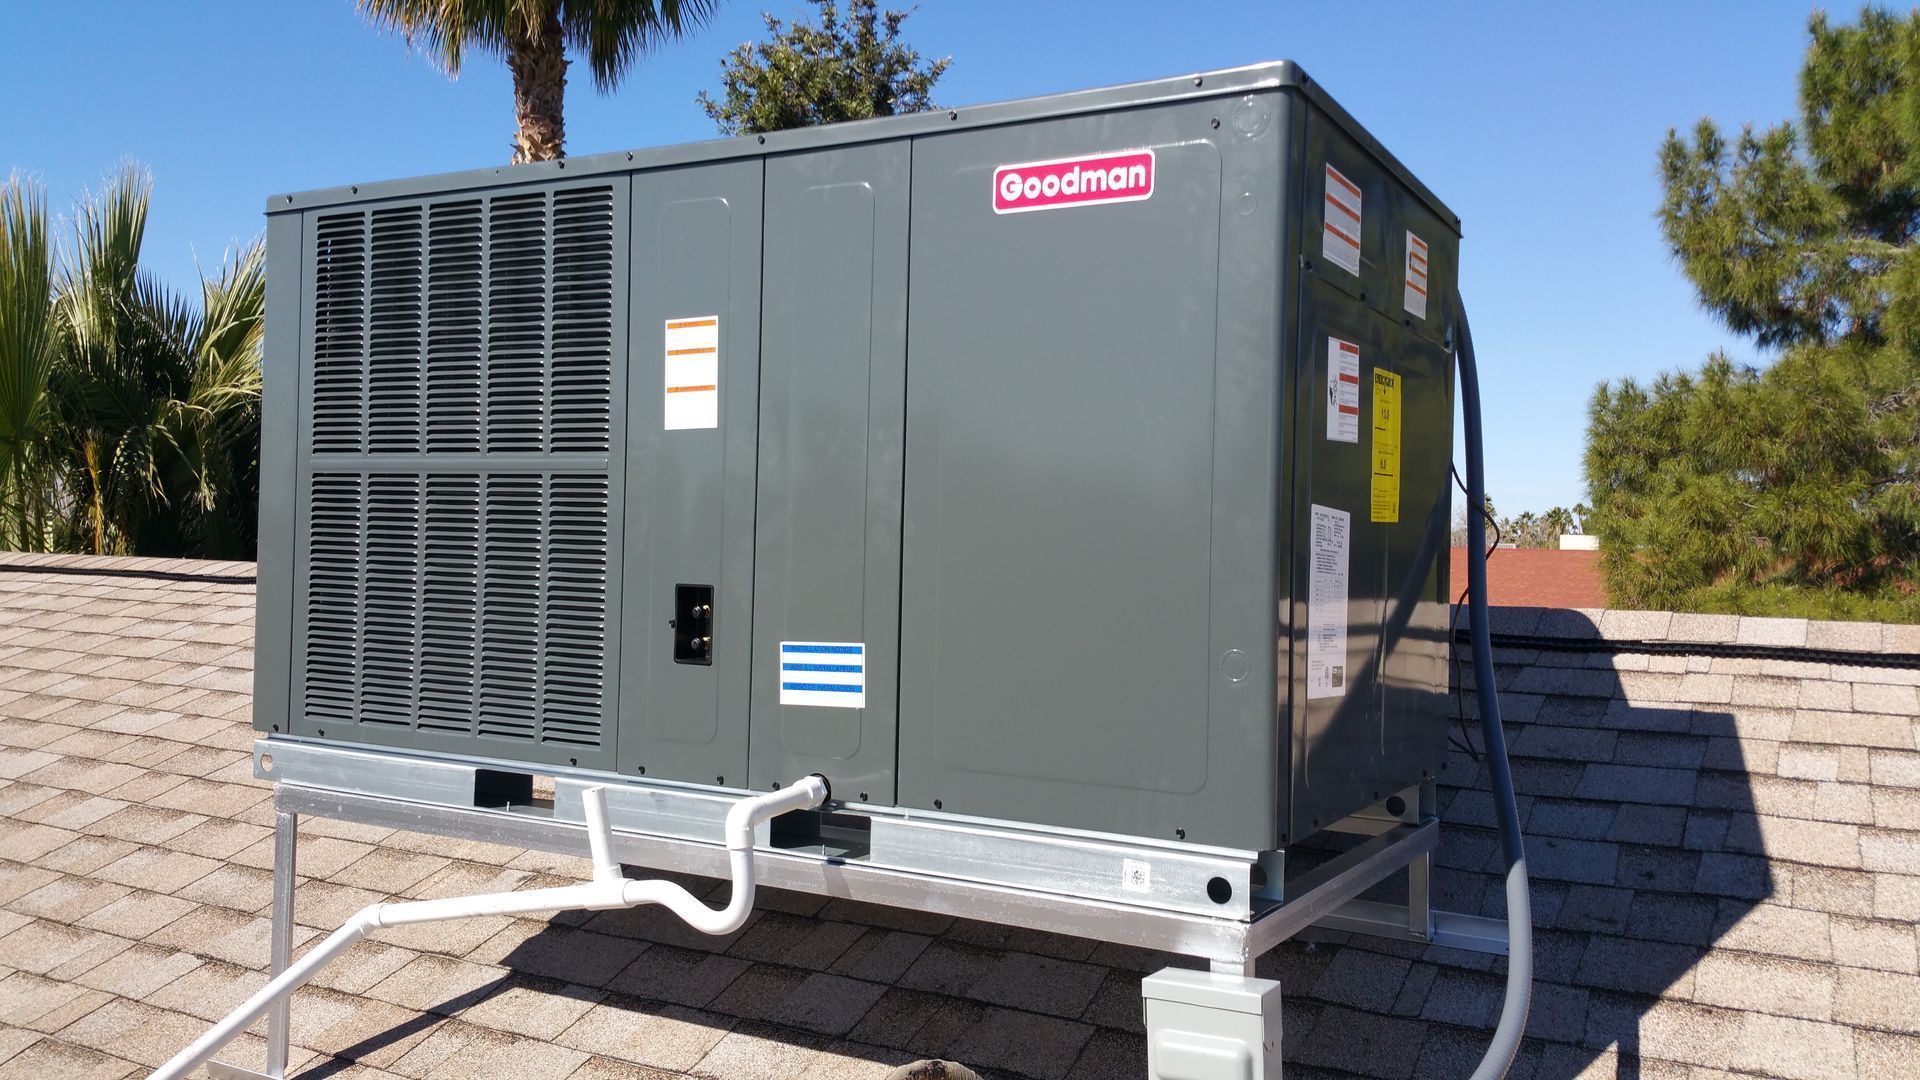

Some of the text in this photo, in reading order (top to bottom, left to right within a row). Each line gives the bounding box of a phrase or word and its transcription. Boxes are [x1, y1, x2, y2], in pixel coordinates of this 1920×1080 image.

[1000, 164, 1146, 202] Goodman
[791, 645, 853, 654] INSTALLATION NOTICE
[790, 683, 807, 691] AVISO
[808, 683, 816, 691] DE
